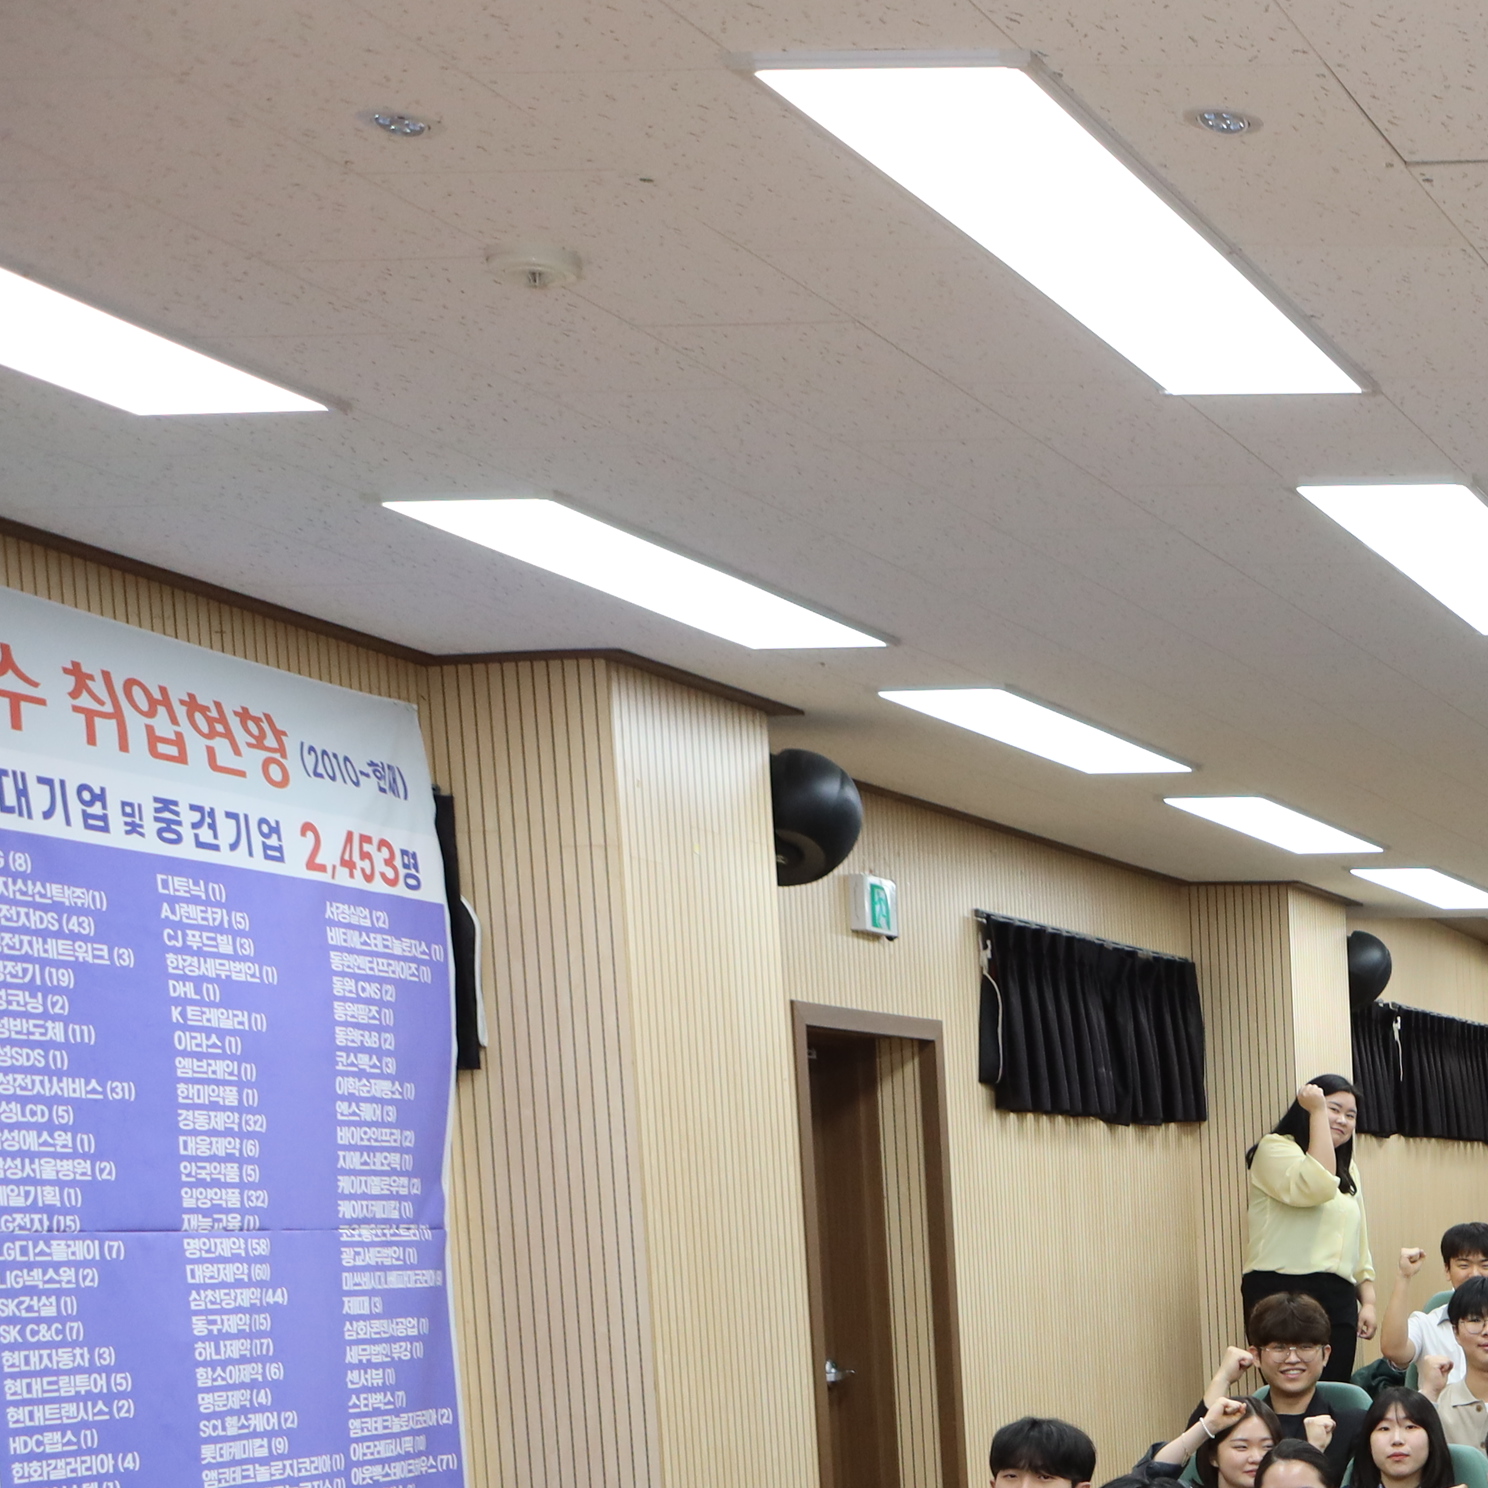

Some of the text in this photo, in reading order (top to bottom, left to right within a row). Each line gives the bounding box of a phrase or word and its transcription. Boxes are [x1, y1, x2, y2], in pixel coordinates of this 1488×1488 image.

[61, 660, 291, 790] 취업현황
[300, 740, 408, 802] (2010~현재)
[0, 768, 111, 834] 대기업
[120, 800, 146, 839] 및
[153, 796, 286, 864] 중견기업
[156, 874, 226, 903] 디토닉 (1)
[161, 902, 249, 931] AJ렌터카 (5)
[373, 910, 389, 929] (2)
[0, 933, 134, 968] 전자네트워크 (3)
[164, 928, 254, 957] CJ 푸드빌 (3)
[166, 953, 278, 985] 한경세무법인 (1)
[169, 980, 220, 1002] DHL (1)
[332, 976, 396, 1002] 동원 CNS (2)
[171, 1006, 267, 1032] K 트레일러 (1)
[174, 1031, 241, 1055] 이라스 (1)
[381, 1032, 395, 1050] (2)
[175, 1057, 256, 1082] 엠브레인 (1)
[336, 1052, 380, 1073] 코스맥스
[107, 1081, 135, 1101] (31)
[176, 1083, 258, 1107] 한미약품 (1)
[53, 1105, 74, 1125] (5)
[177, 1109, 266, 1133] 경동제약 (32)
[0, 1129, 95, 1153] 성에스원 (1)
[179, 1136, 259, 1158] 대웅제약 (6)
[0, 1157, 116, 1181] 성서울병원 (2)
[180, 1161, 259, 1183] 안국약품 (5)
[181, 1188, 268, 1208] 일양약품 (32)
[104, 1241, 124, 1260] (7)
[183, 1238, 271, 1258] 명인제약 (58)
[186, 1263, 248, 1283] 대원제약
[0, 1296, 77, 1317] SK건설 (1)
[189, 1287, 288, 1310] 삼천당제약 (44)
[0, 1321, 83, 1343] SK C&C (7)
[192, 1313, 271, 1336] 동구제약 (15)
[2, 1346, 115, 1372] 현대자동차 (3)
[194, 1338, 273, 1361] 하나제약 (17)
[4, 1372, 132, 1400] 현대드림투어 (5)
[195, 1362, 284, 1387] 함소아제약 (6)
[198, 1388, 271, 1413] 명문제약 (4)
[7, 1399, 134, 1428] 현대트랜시스 (2)
[200, 1410, 298, 1437] SCL헬스케어 (2)
[438, 1408, 453, 1425] (2)
[10, 1429, 98, 1454] HDC랩스 (1)
[12, 1452, 140, 1484] 한화갤러리아 (4)
